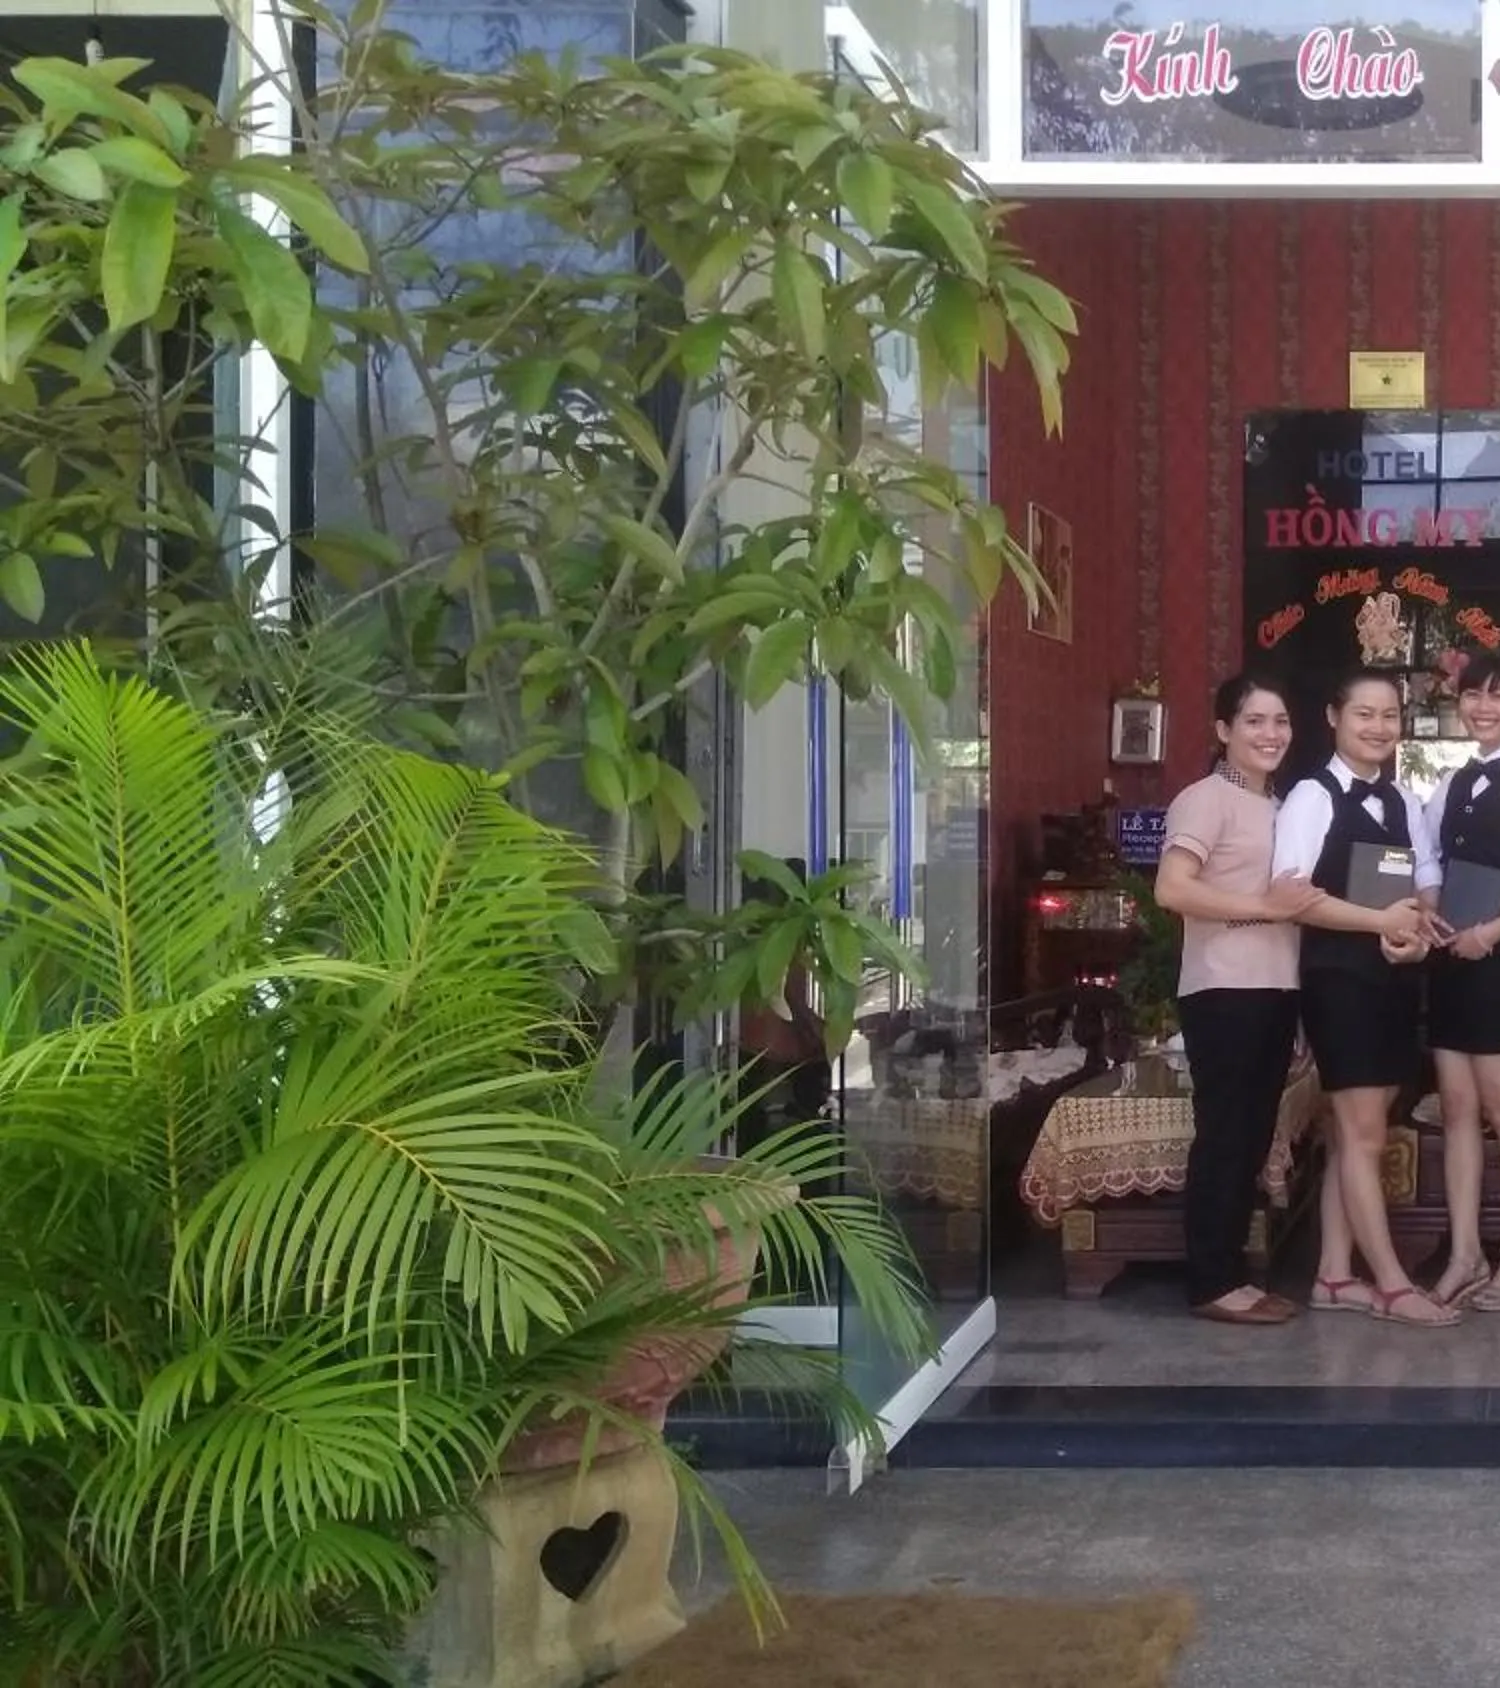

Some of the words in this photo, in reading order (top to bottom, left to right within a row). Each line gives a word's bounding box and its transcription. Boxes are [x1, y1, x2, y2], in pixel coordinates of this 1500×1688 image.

[1101, 21, 1238, 105] Kính
[1297, 25, 1424, 100] Chào
[1318, 451, 1435, 478] HOTEL
[1265, 483, 1398, 547] HỒNG
